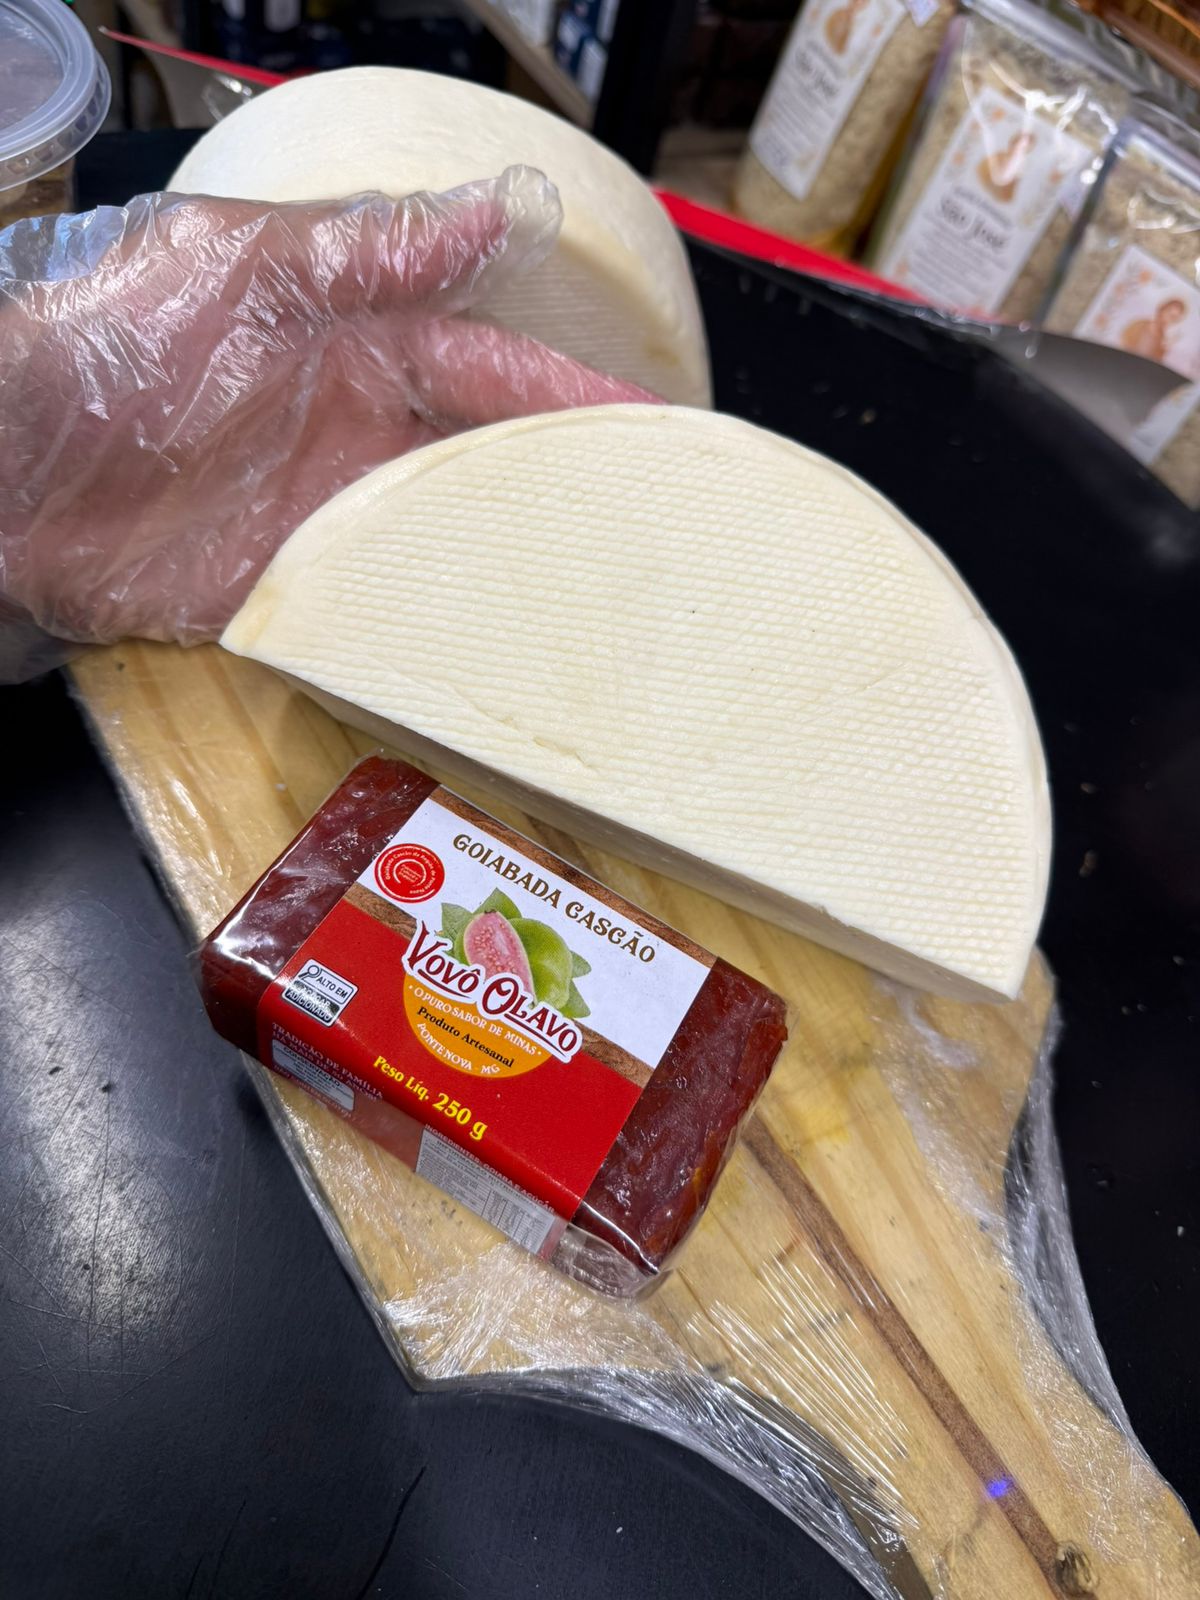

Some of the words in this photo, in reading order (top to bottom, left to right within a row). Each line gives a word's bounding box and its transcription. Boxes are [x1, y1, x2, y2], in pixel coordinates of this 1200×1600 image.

[453, 833, 562, 908] GOIABADA
[565, 901, 655, 963] CASCÃO
[286, 989, 332, 1022] ADICIONADO
[315, 976, 337, 991] ALTO
[335, 987, 348, 999] EM
[417, 1006, 461, 1037] Produto
[461, 1034, 515, 1068] Artesanal
[417, 1022, 444, 1055] PONTE
[444, 1049, 473, 1071] NOVA
[480, 1063, 501, 1075] MG
[422, 994, 452, 1014] PURO
[451, 1007, 487, 1029] SABOR
[488, 1024, 504, 1036] DE
[504, 1032, 537, 1056] MINAS
[272, 1022, 324, 1060] TRADIÇÃO
[325, 1057, 340, 1069] DE
[341, 1067, 383, 1098] FAMÍLIA
[373, 1055, 405, 1082] Peso
[405, 1075, 430, 1101] Líq.
[432, 1092, 472, 1125] 250
[469, 1120, 489, 1141] g
